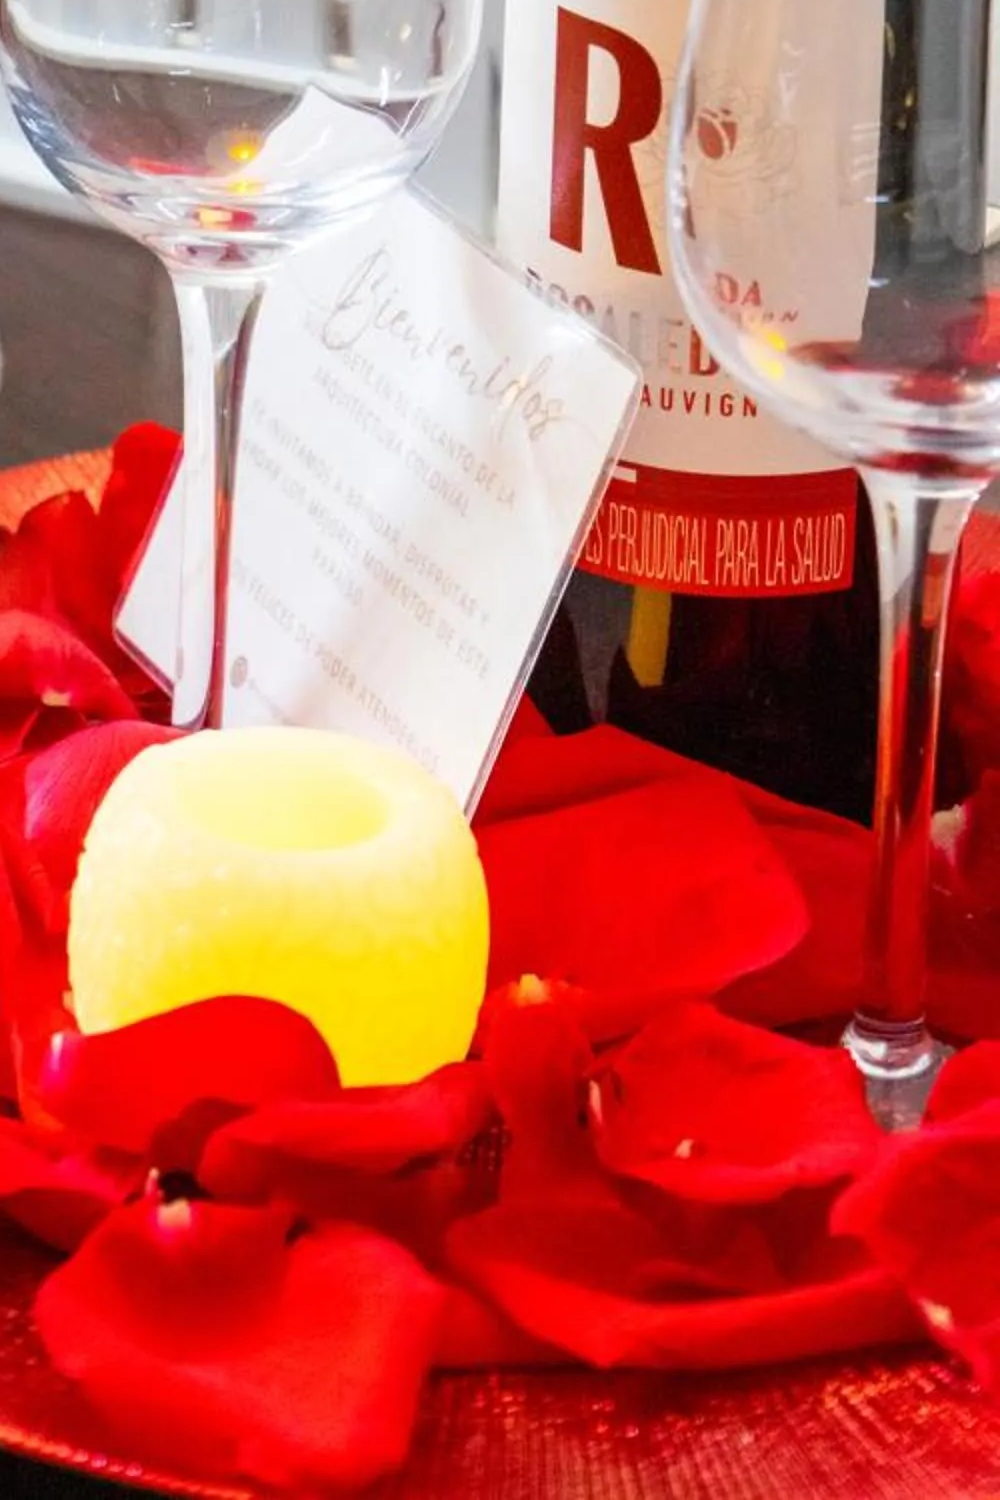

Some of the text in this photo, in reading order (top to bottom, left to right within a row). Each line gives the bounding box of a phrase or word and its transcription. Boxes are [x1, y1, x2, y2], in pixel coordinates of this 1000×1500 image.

[549, 4, 663, 277] R
[320, 242, 568, 445] Bienvenidos
[640, 384, 758, 417] AUVIGN
[606, 501, 710, 586] PERJUDICIAL
[714, 518, 759, 588] PARA
[764, 519, 787, 587] LA
[791, 512, 847, 585] SALUD
